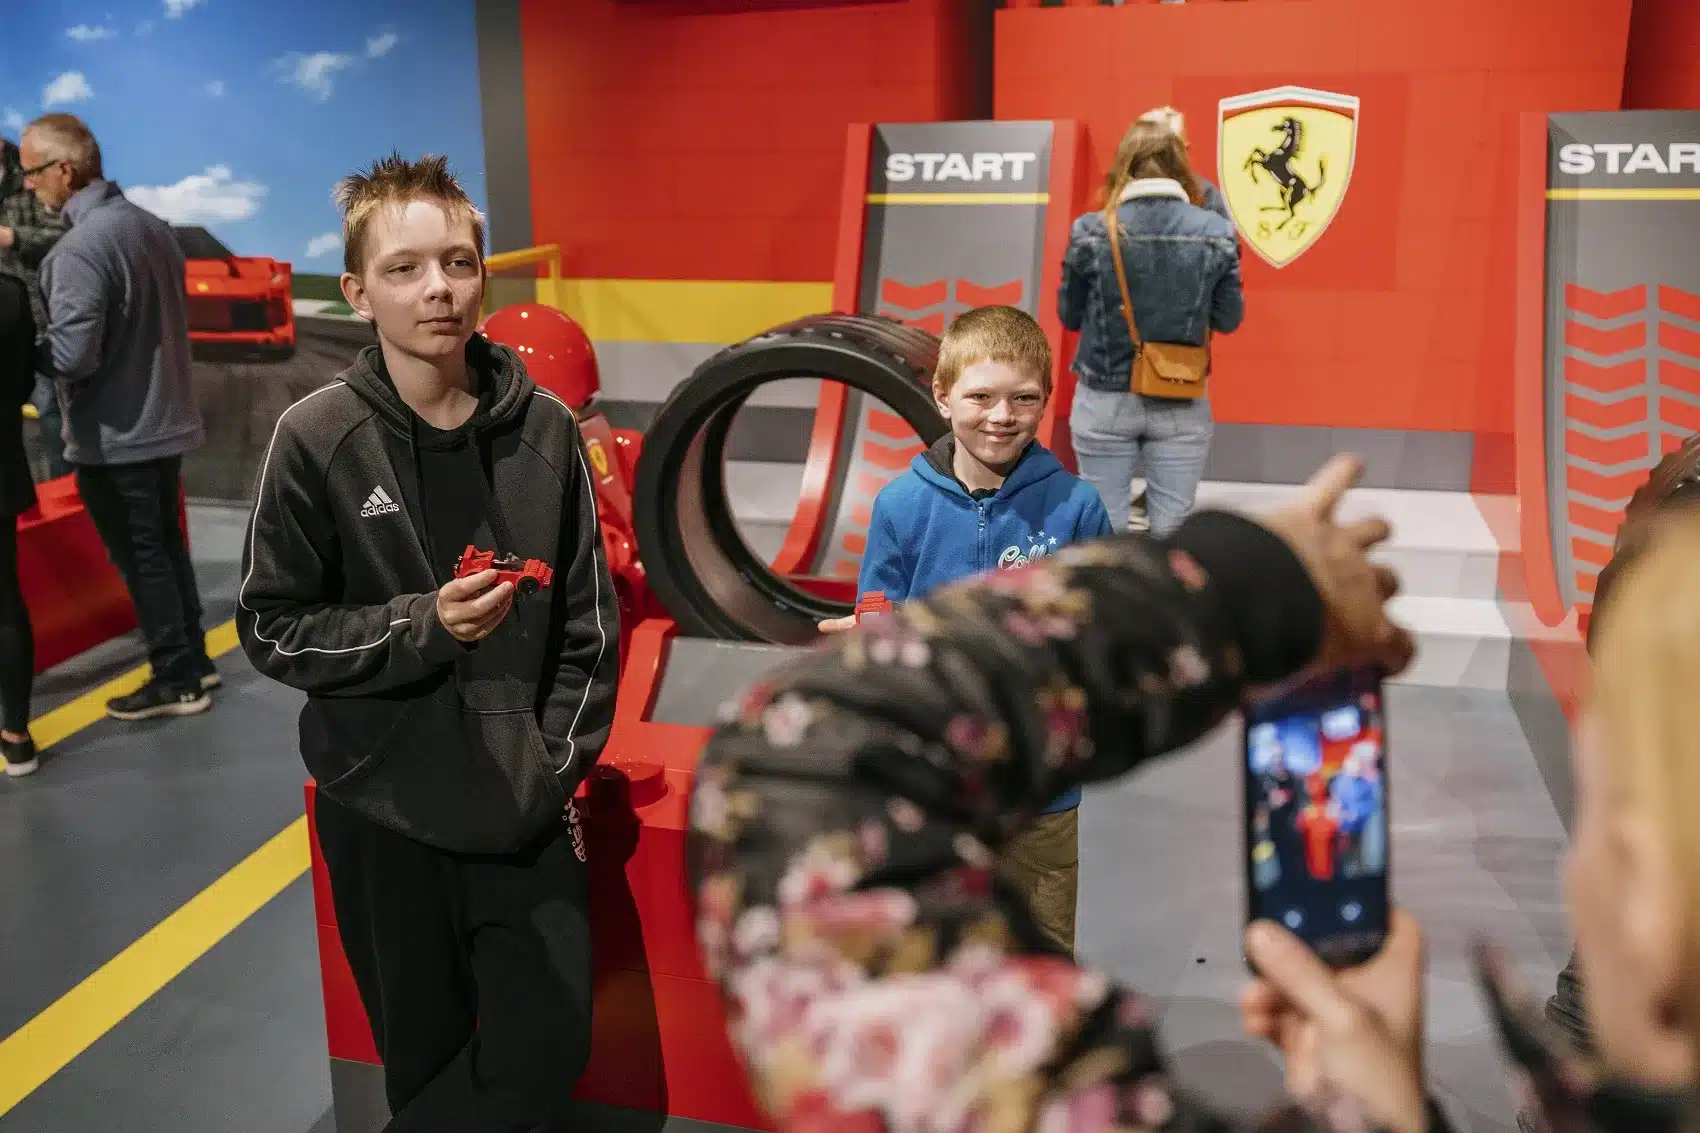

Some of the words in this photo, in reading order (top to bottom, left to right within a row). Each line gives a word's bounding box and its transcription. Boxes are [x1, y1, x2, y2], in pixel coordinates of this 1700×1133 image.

[885, 152, 1036, 182] START
[360, 503, 400, 517] adidas
[998, 544, 1052, 570] Coll
